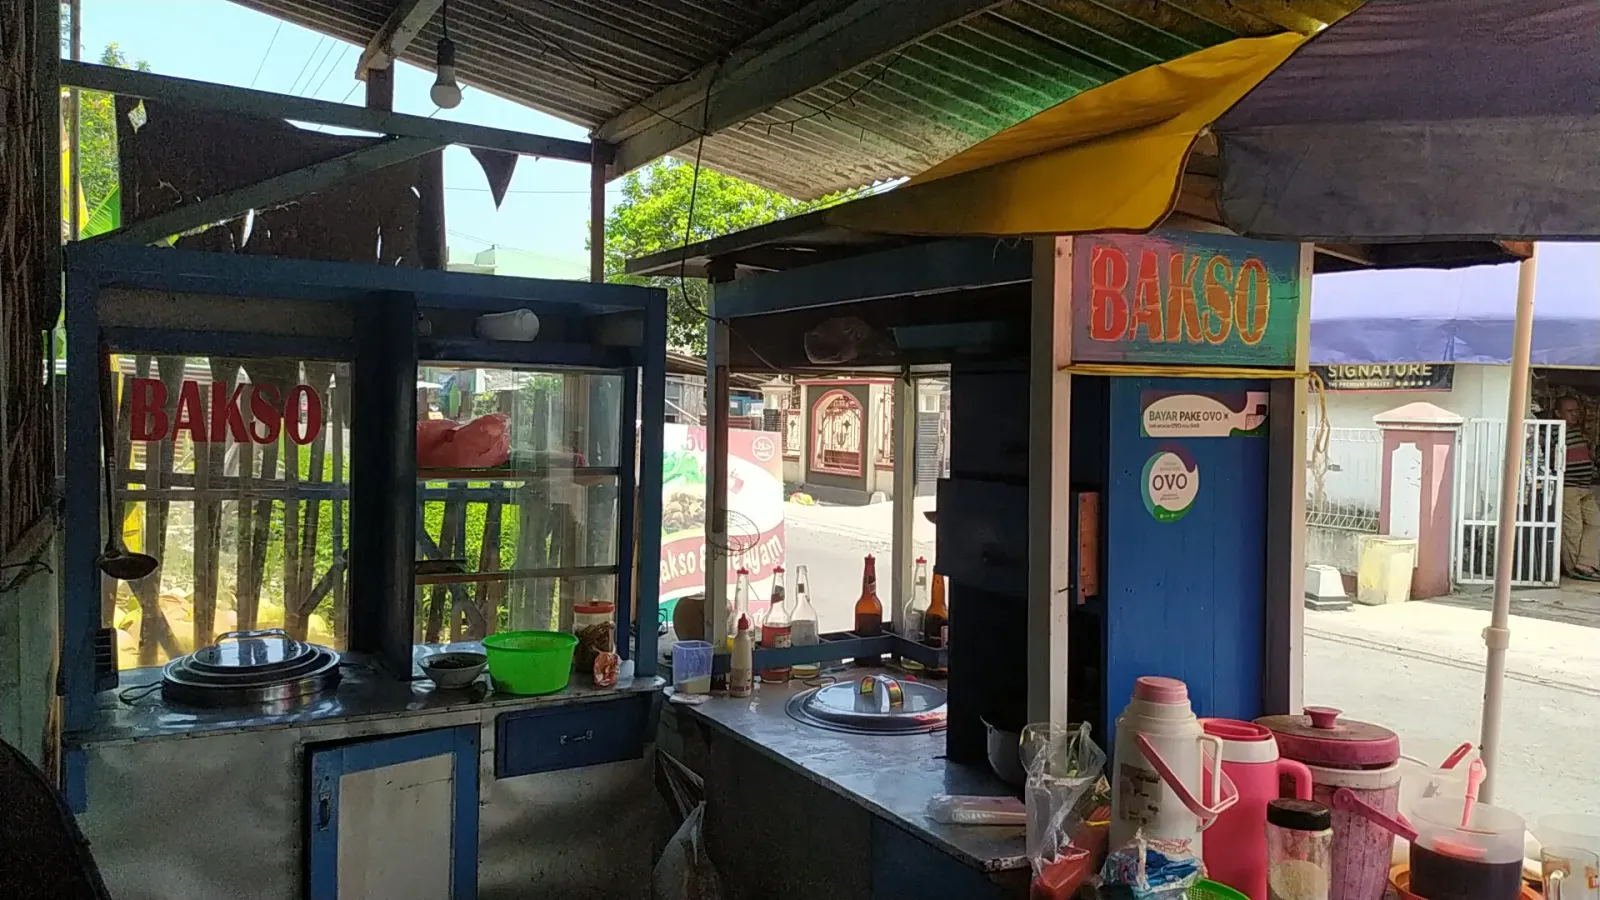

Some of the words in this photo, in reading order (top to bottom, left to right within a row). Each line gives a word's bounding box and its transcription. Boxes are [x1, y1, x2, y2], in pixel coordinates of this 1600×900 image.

[1090, 247, 1270, 345] BAKSO
[1328, 363, 1433, 378] SIGNATURE
[129, 377, 322, 445] BAKSO
[1148, 410, 1178, 421] BAYAR
[1179, 410, 1202, 421] PAKE
[1202, 410, 1222, 421] OVO
[1152, 473, 1188, 491] OVO
[661, 548, 696, 584] akso
[742, 534, 784, 575] Ayam
